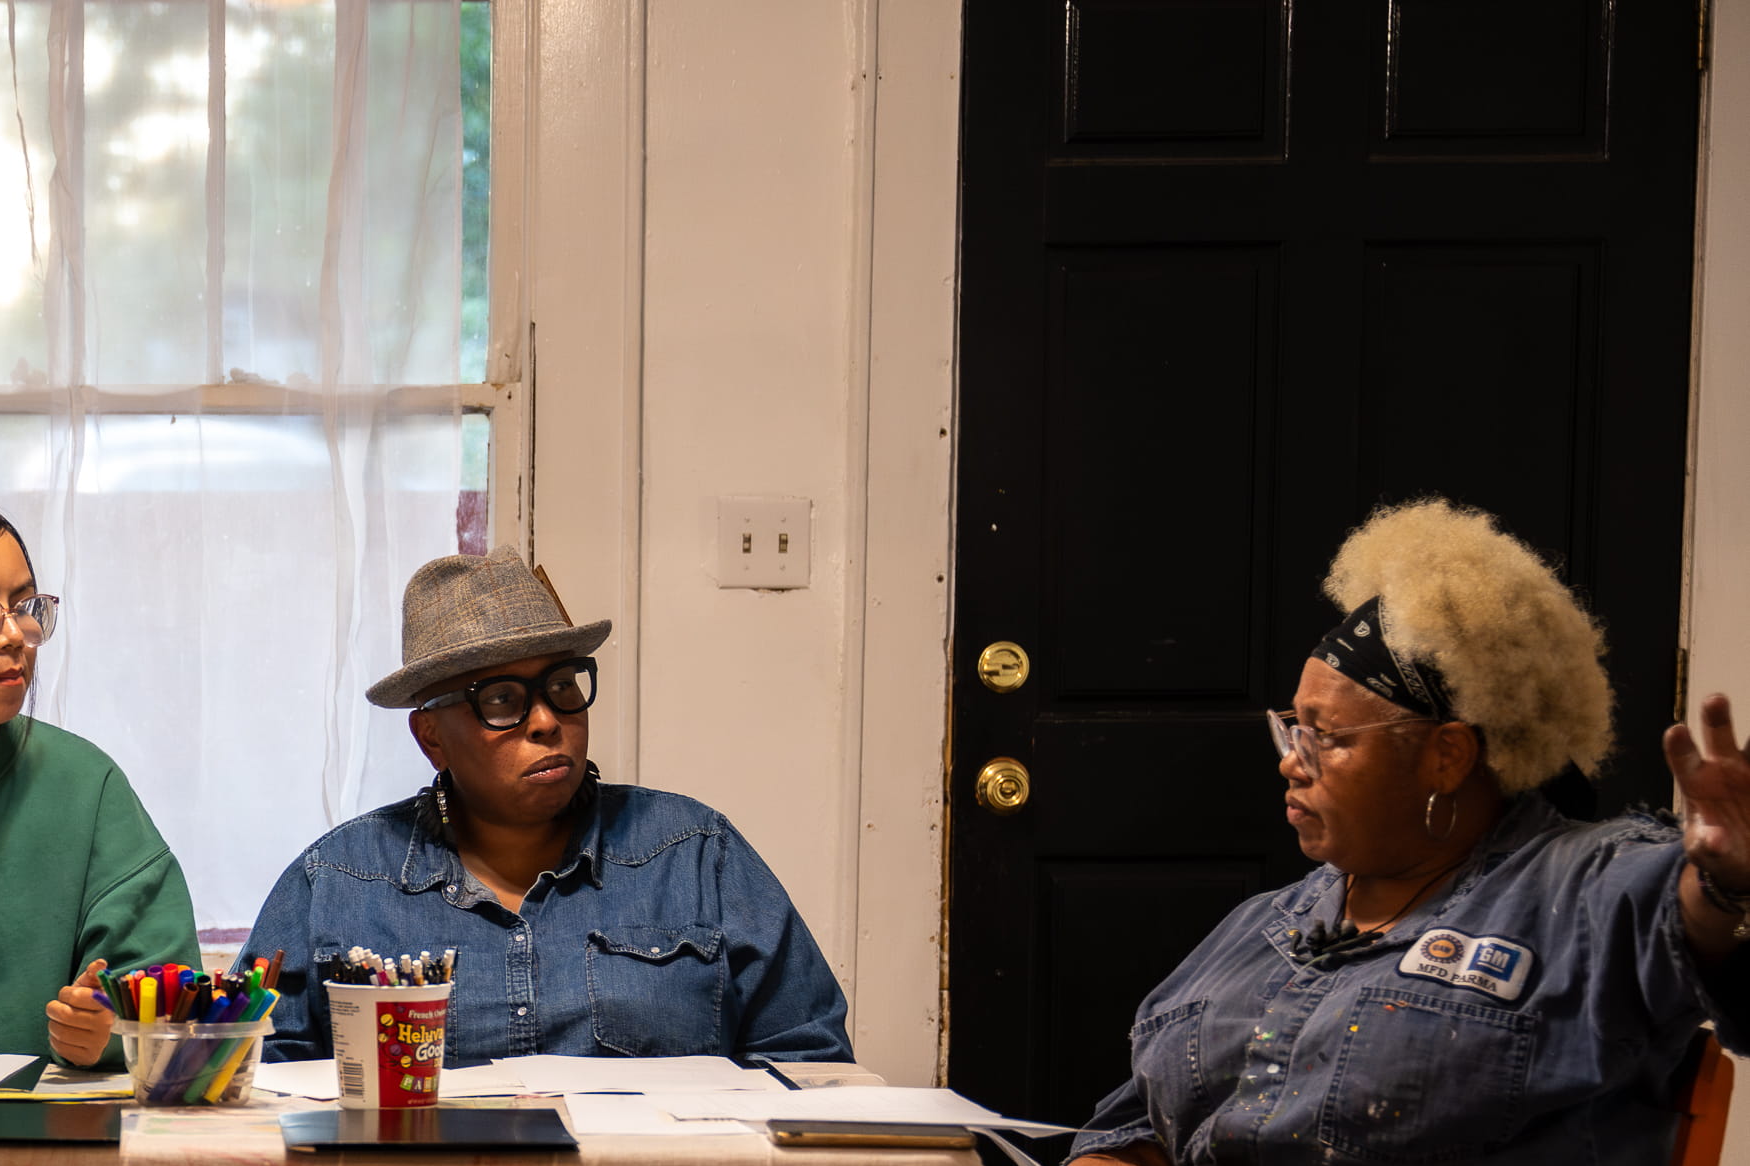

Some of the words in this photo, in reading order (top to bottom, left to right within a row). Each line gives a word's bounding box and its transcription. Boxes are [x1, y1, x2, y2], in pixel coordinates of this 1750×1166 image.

[1479, 947, 1511, 969] GM
[1416, 963, 1448, 978] MFD
[1450, 973, 1498, 992] PARMA
[408, 1009, 433, 1019] French
